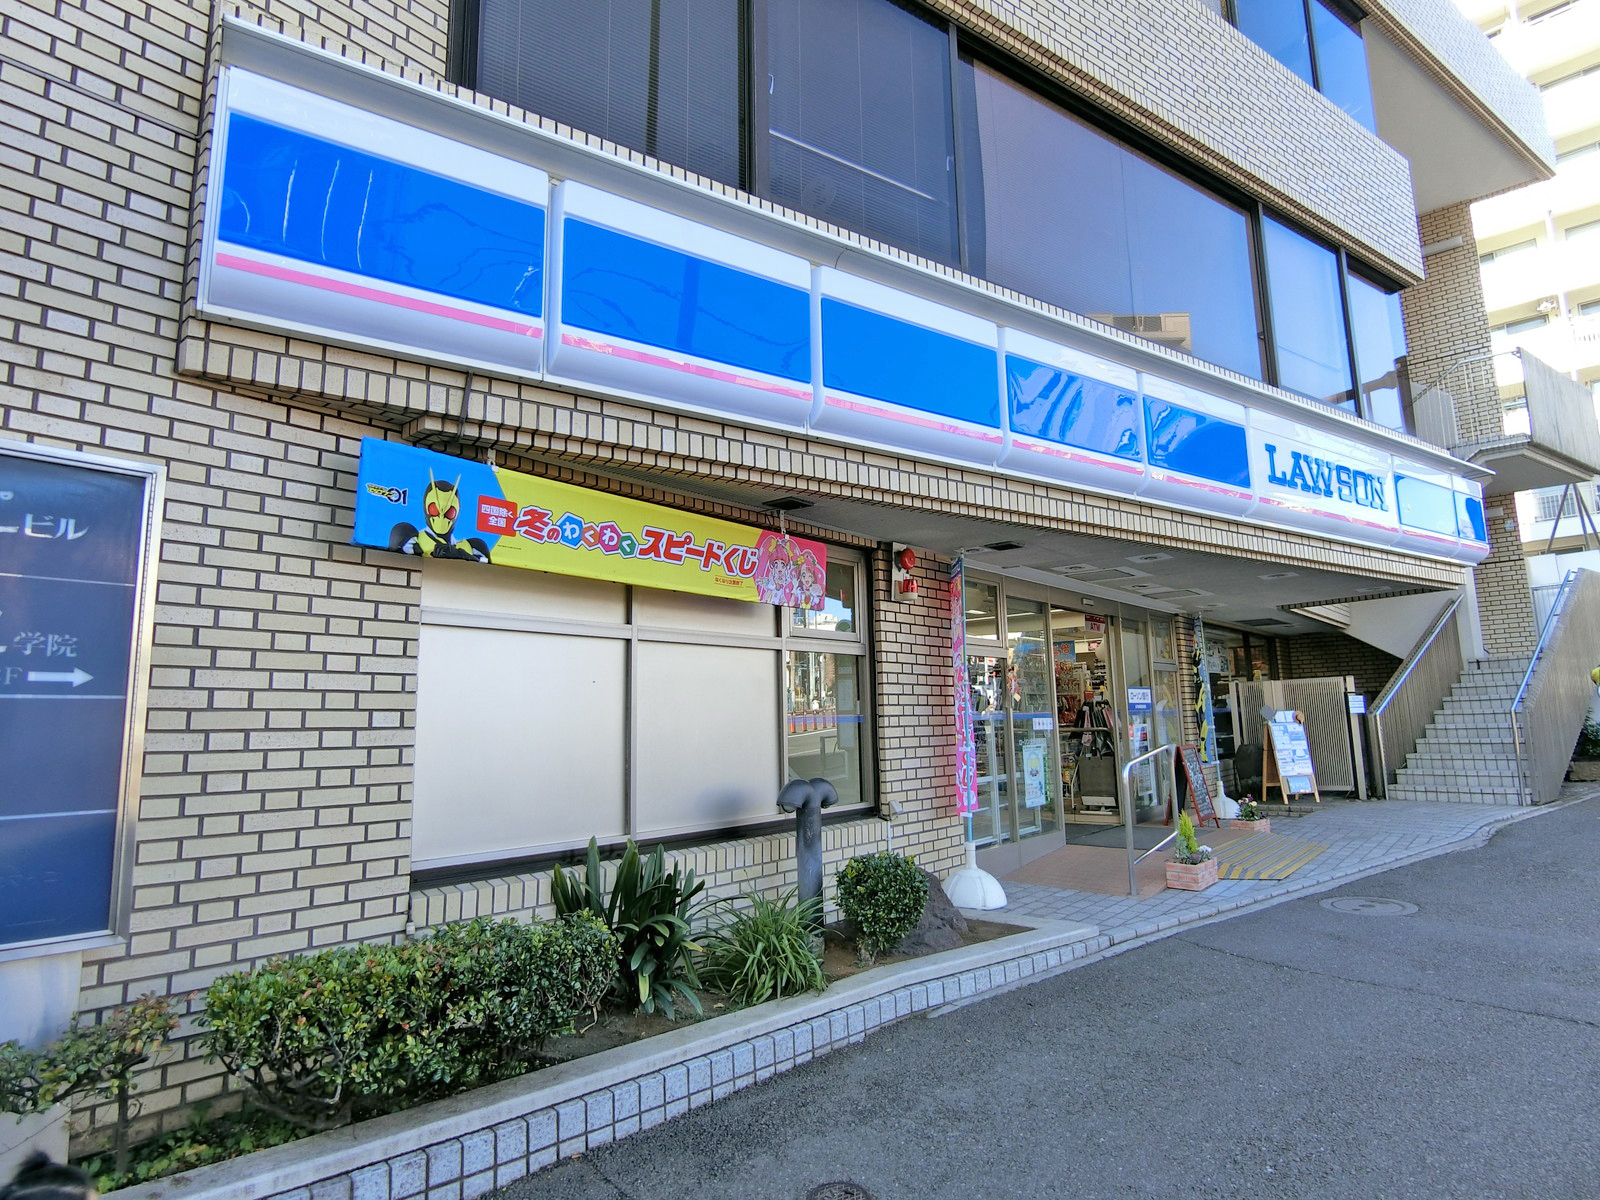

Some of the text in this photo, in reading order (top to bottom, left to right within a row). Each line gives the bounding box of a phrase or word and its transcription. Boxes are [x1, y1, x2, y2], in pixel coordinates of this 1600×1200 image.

[1265, 443, 1389, 512] LAWSON
[481, 504, 514, 519] 四国除く
[488, 516, 507, 528] 全国
[514, 506, 759, 577] 冬のわくわくスピードくじ
[0, 631, 79, 658] 学院
